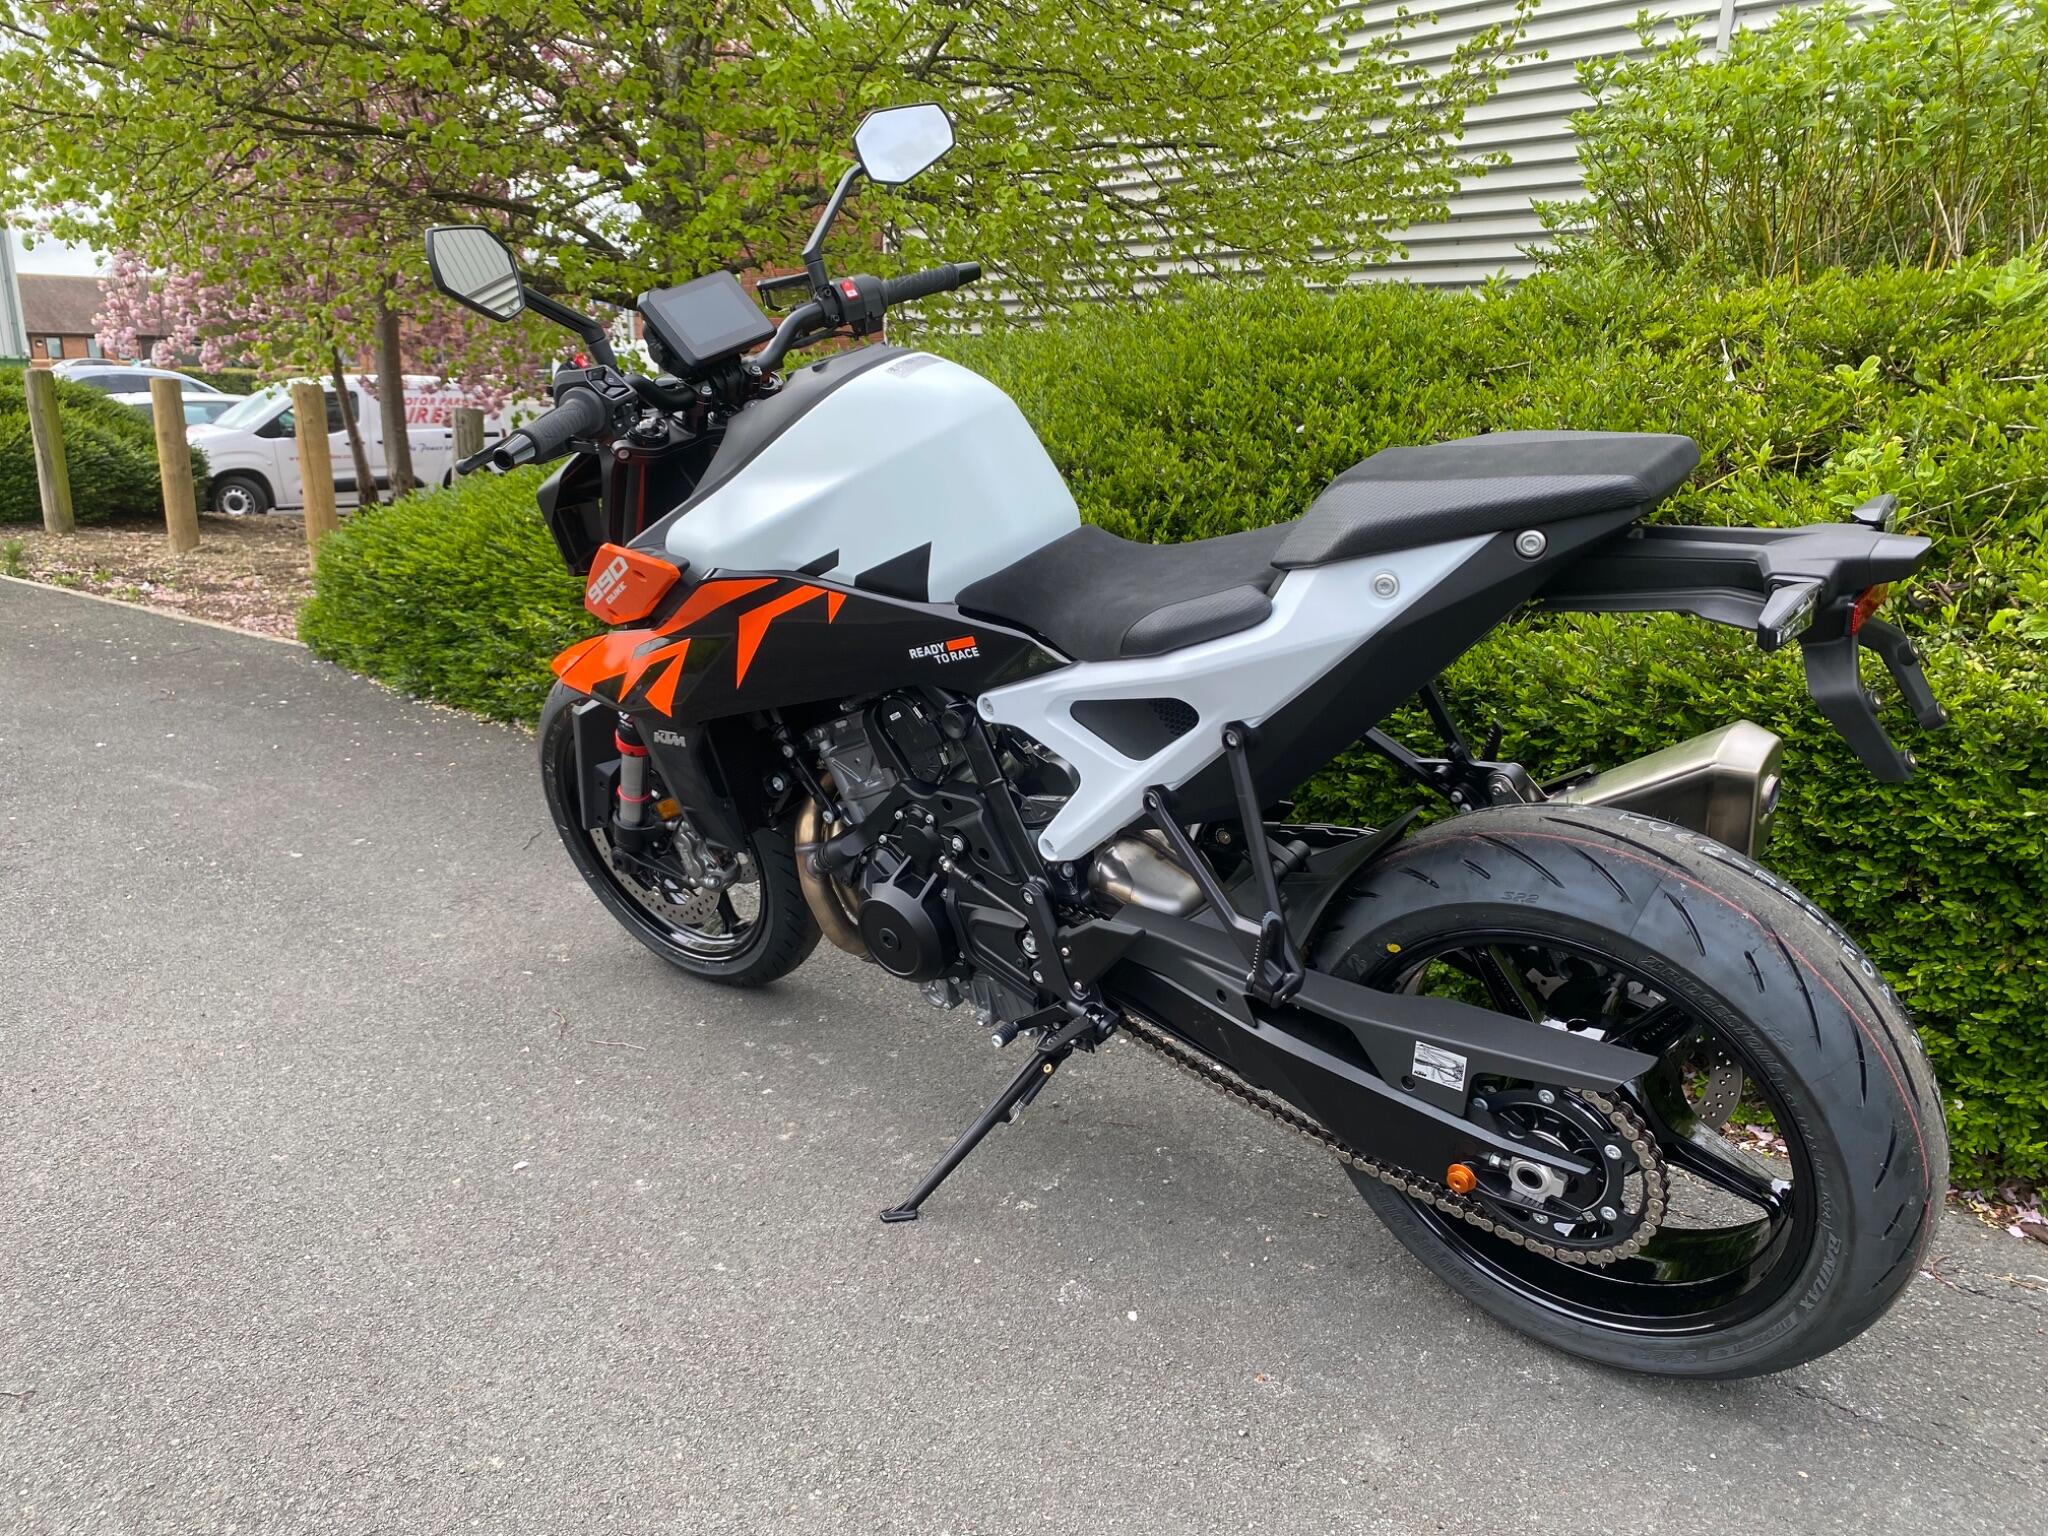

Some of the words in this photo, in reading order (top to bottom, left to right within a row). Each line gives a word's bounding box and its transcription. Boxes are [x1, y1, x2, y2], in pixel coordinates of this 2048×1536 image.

[404, 397, 436, 406] OTOR
[587, 555, 629, 606] 990
[908, 642, 945, 660] READY
[933, 653, 950, 664] TO
[949, 646, 981, 662] RACE
[653, 729, 687, 748] KTM
